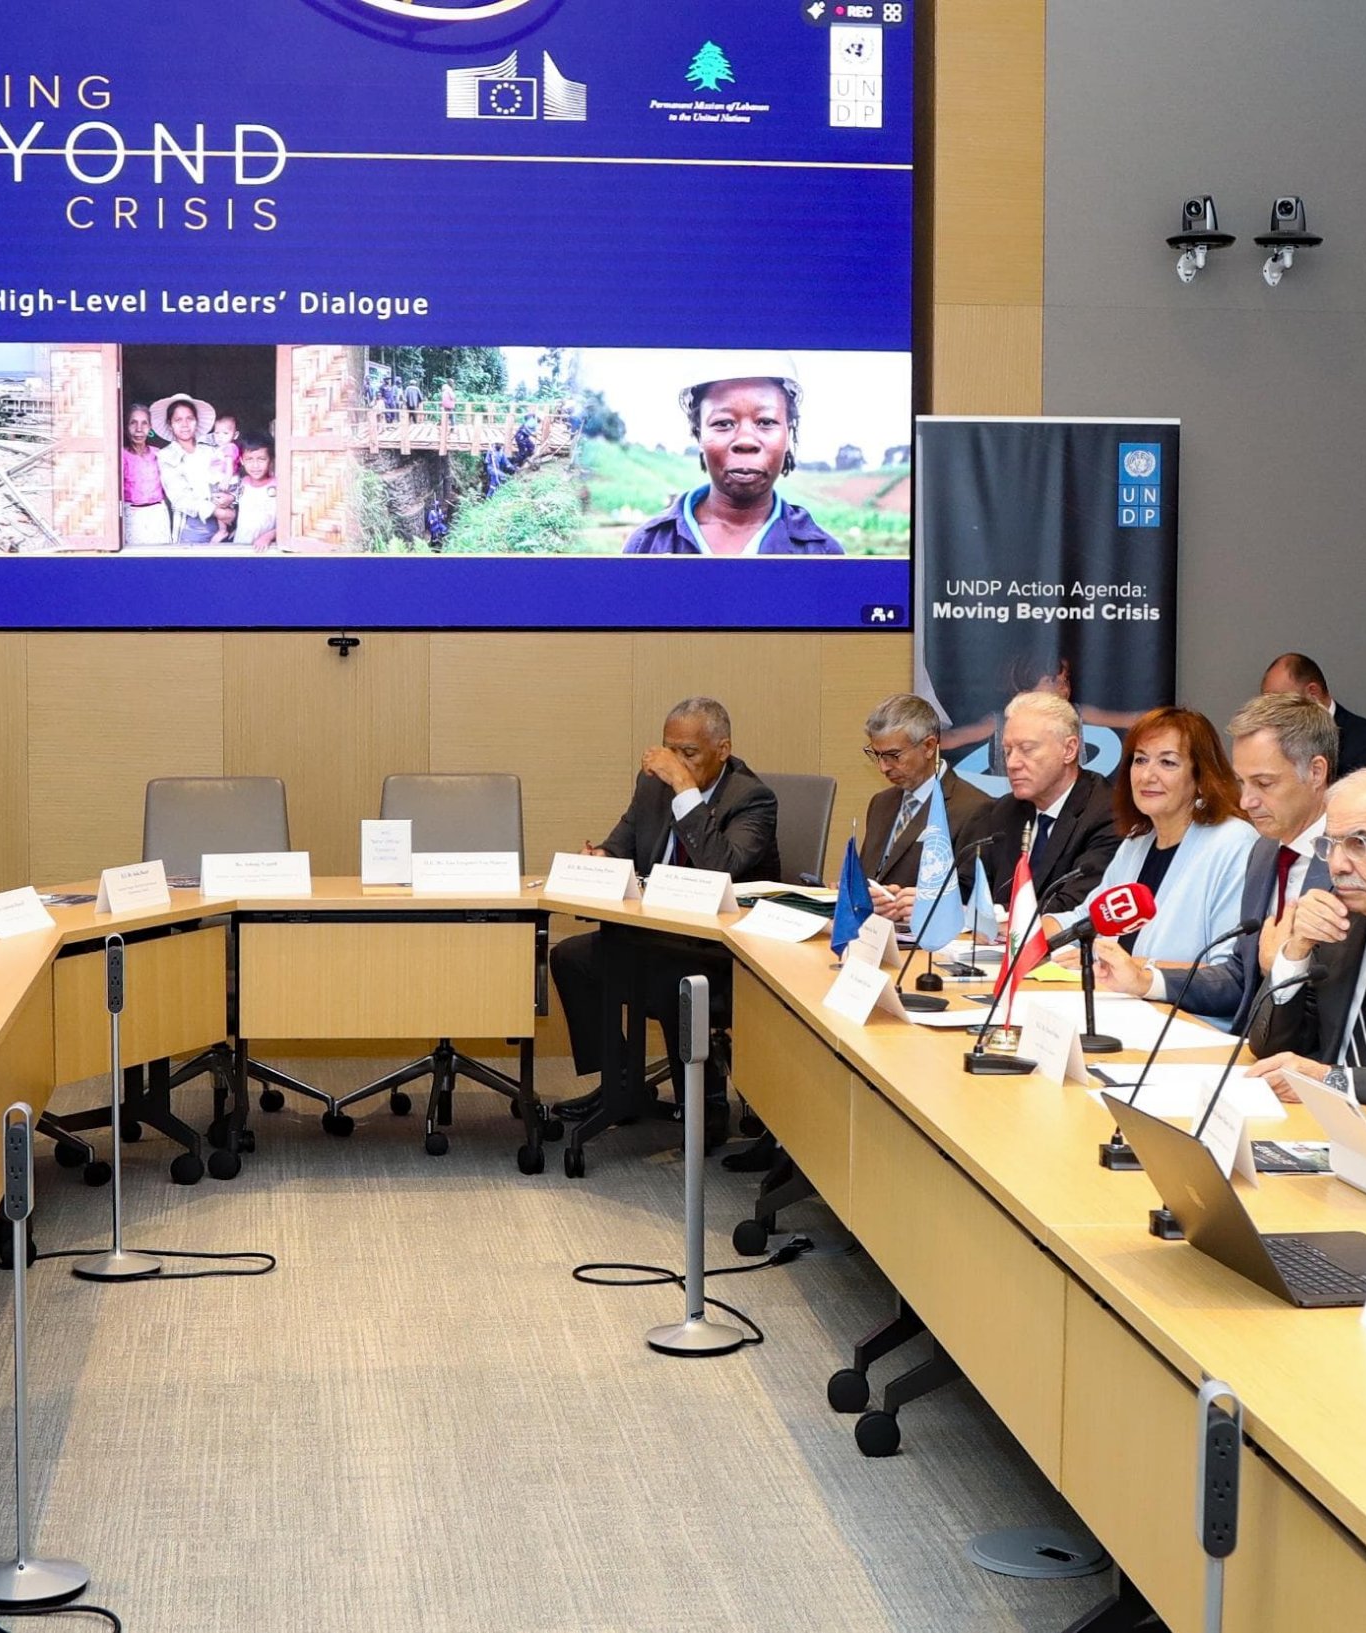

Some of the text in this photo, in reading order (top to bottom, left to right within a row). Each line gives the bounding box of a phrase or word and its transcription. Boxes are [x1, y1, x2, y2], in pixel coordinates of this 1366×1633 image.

[846, 5, 873, 18] REC
[836, 79, 876, 97] UN
[836, 104, 875, 122] DP
[65, 196, 278, 231] CRISIS
[299, 291, 430, 320] Dialogue
[1122, 487, 1157, 503] UN
[1122, 508, 1156, 525] DP
[946, 579, 1148, 601] UNDP Action Agenda:
[932, 602, 1161, 624] Moving Beyond Crisis
